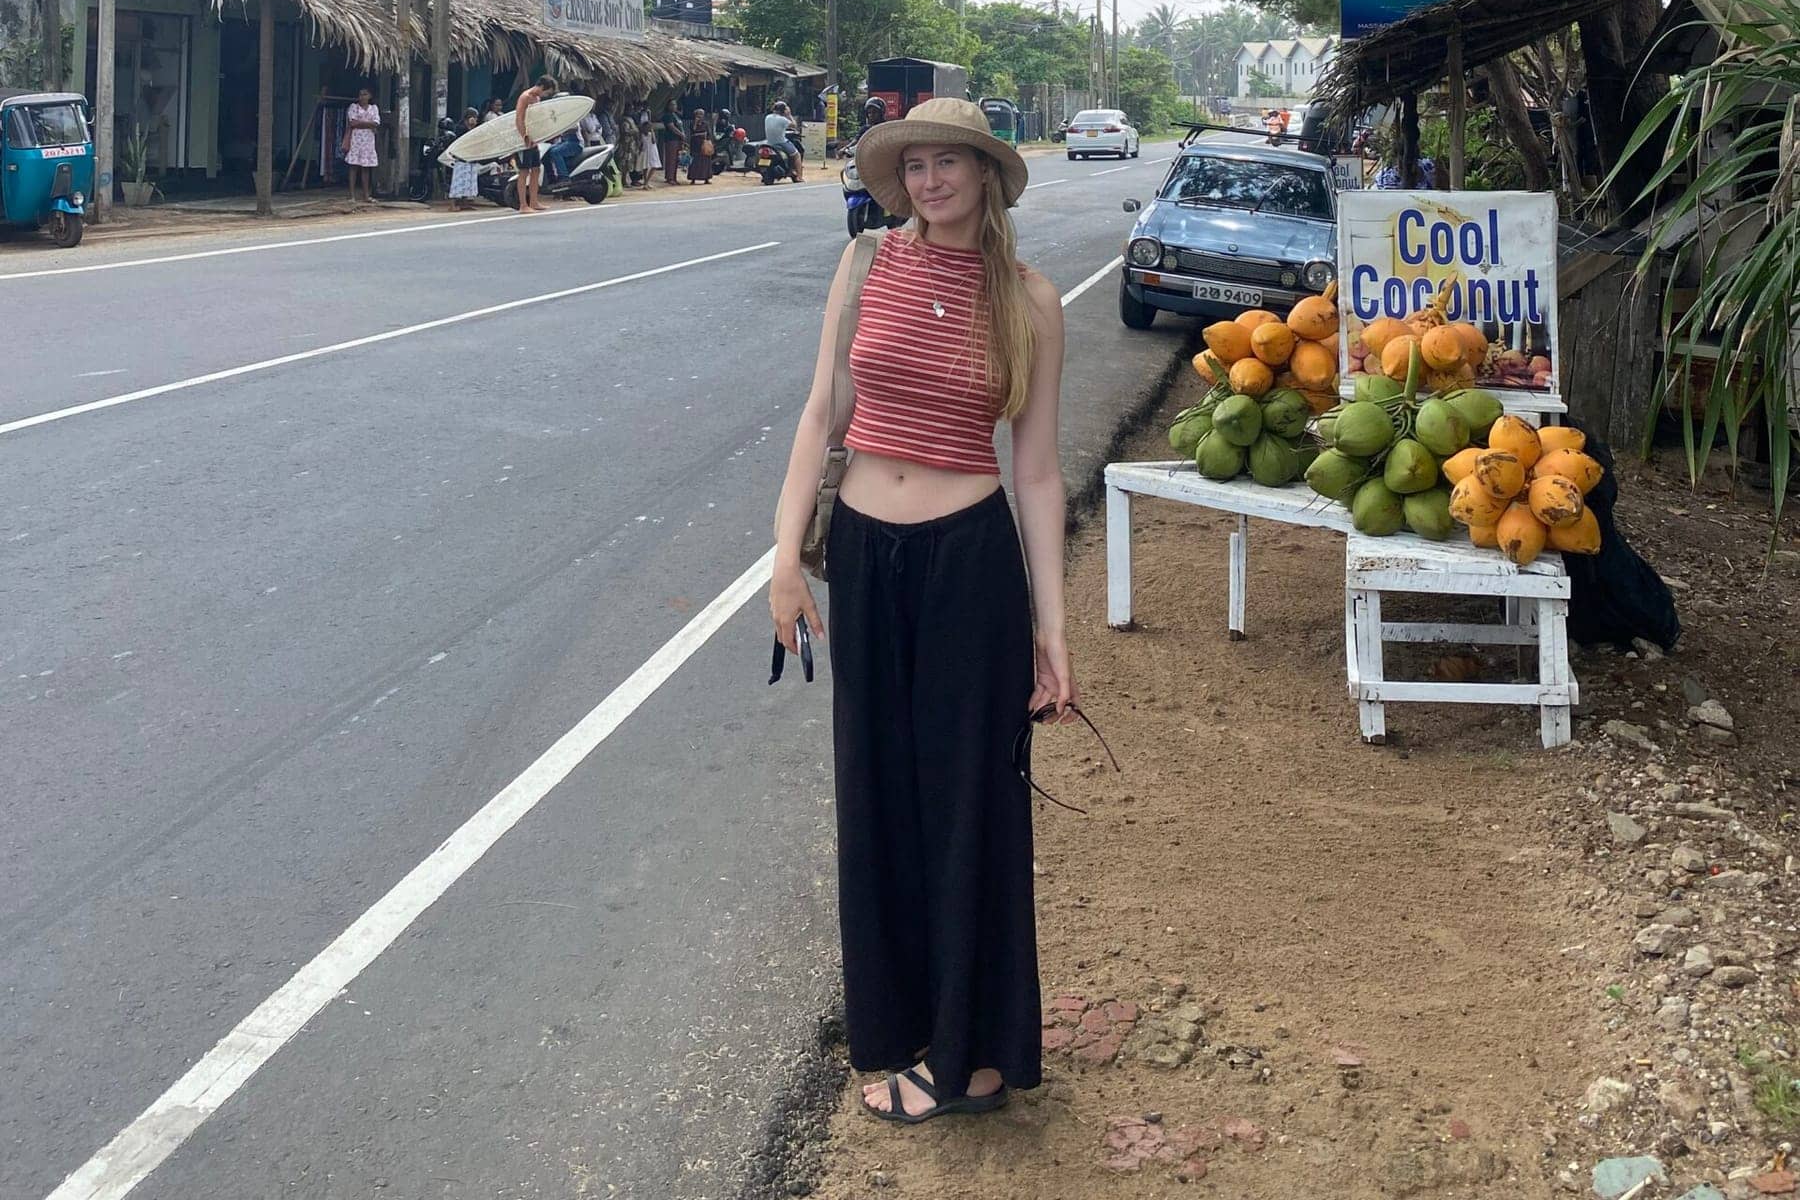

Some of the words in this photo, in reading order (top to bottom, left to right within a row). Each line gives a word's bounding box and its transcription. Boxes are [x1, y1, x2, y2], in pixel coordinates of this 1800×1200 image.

[1334, 163, 1349, 177] ool
[1398, 208, 1499, 265] Cool
[1223, 289, 1261, 305] 9409
[1352, 264, 1542, 323] Coconut
